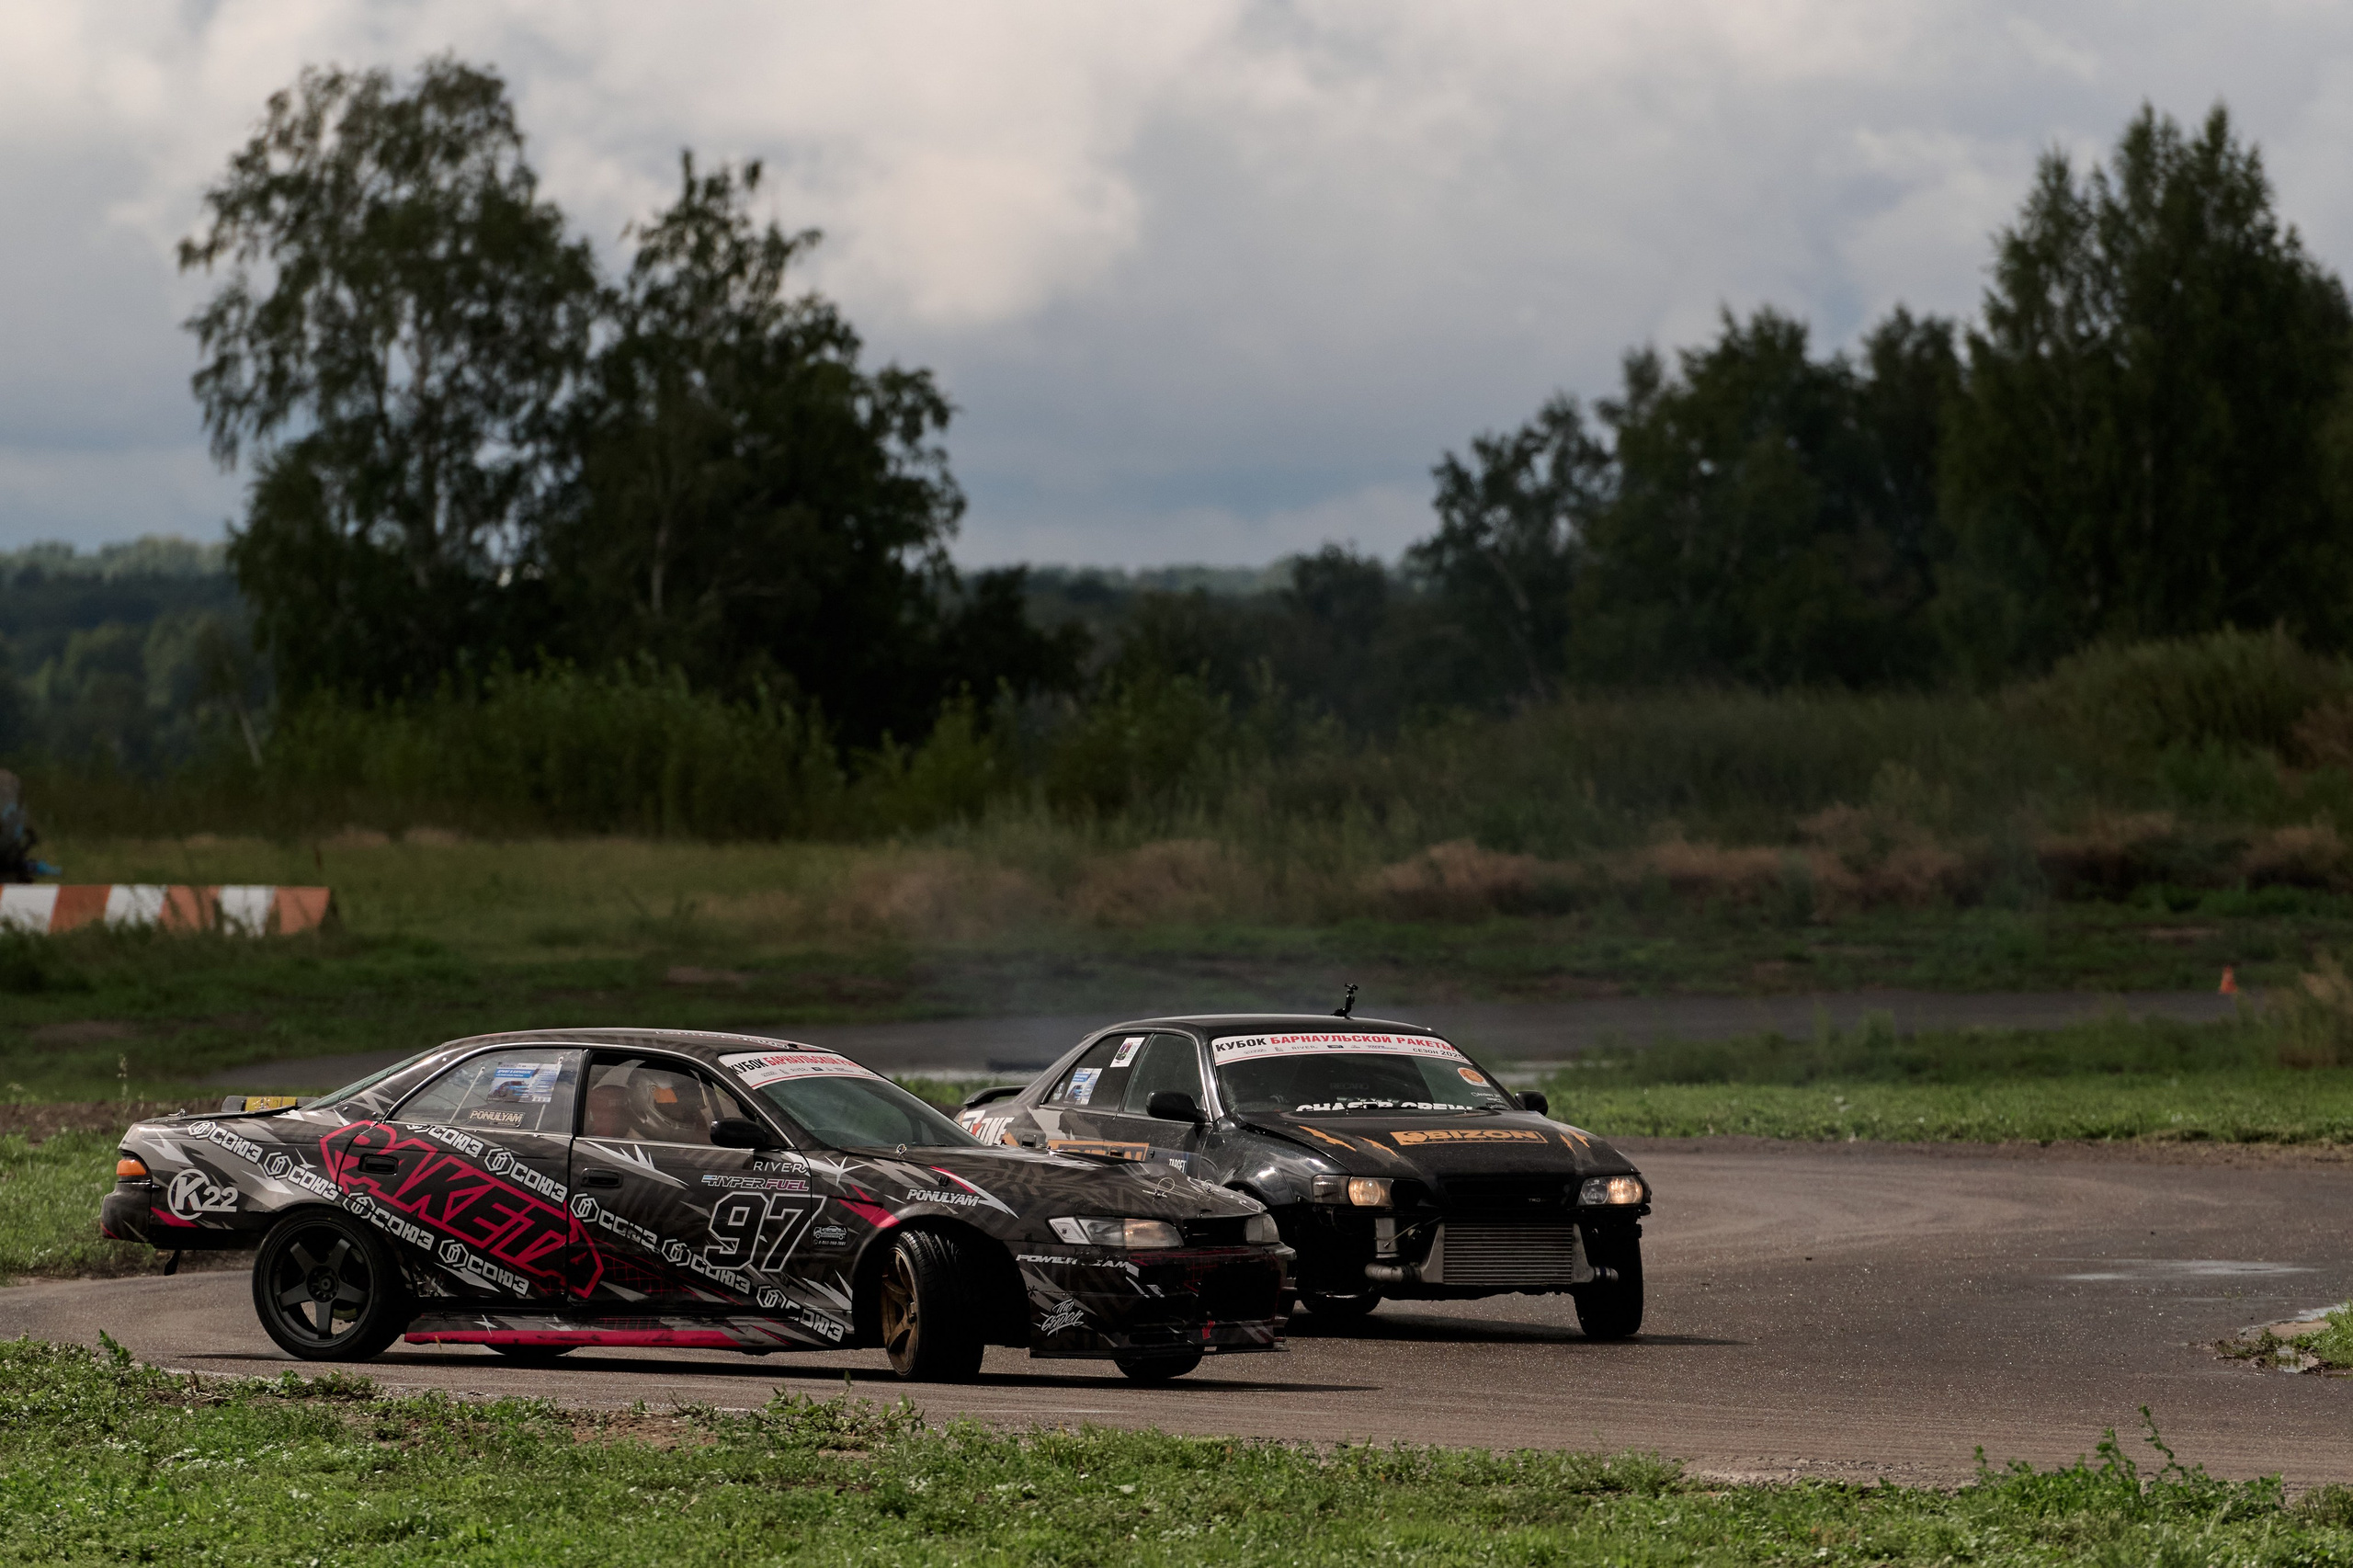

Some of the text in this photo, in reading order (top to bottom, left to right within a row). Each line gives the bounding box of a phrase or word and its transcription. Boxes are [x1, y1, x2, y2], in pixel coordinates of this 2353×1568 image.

[1215, 1038, 1267, 1052] КУБОК
[1270, 1034, 1392, 1045] БАРНАУЛЬСКОЙ
[1396, 1037, 1458, 1052] РАКЕТЫ
[727, 1058, 767, 1074] КУБОК
[764, 1055, 838, 1066] БАРНАУЛЬСКОЙ
[470, 1110, 523, 1122] PONULYAM
[210, 1127, 263, 1165] СОЮЗ
[428, 1126, 484, 1158] СОЮЗ
[1427, 1130, 1539, 1140] BIZON
[288, 1165, 342, 1201] СОЮЗ
[753, 1161, 805, 1173] RIVER
[508, 1165, 568, 1204] СОЮЗ
[906, 1188, 980, 1207] PONULYAM
[370, 1208, 435, 1251] СОЮЗ
[598, 1209, 659, 1251] СОЮЗ
[703, 1191, 827, 1273] 97
[467, 1254, 530, 1296] СОЮЗ
[690, 1254, 751, 1295] СОЮЗ
[1016, 1254, 1131, 1268] POWER EAM
